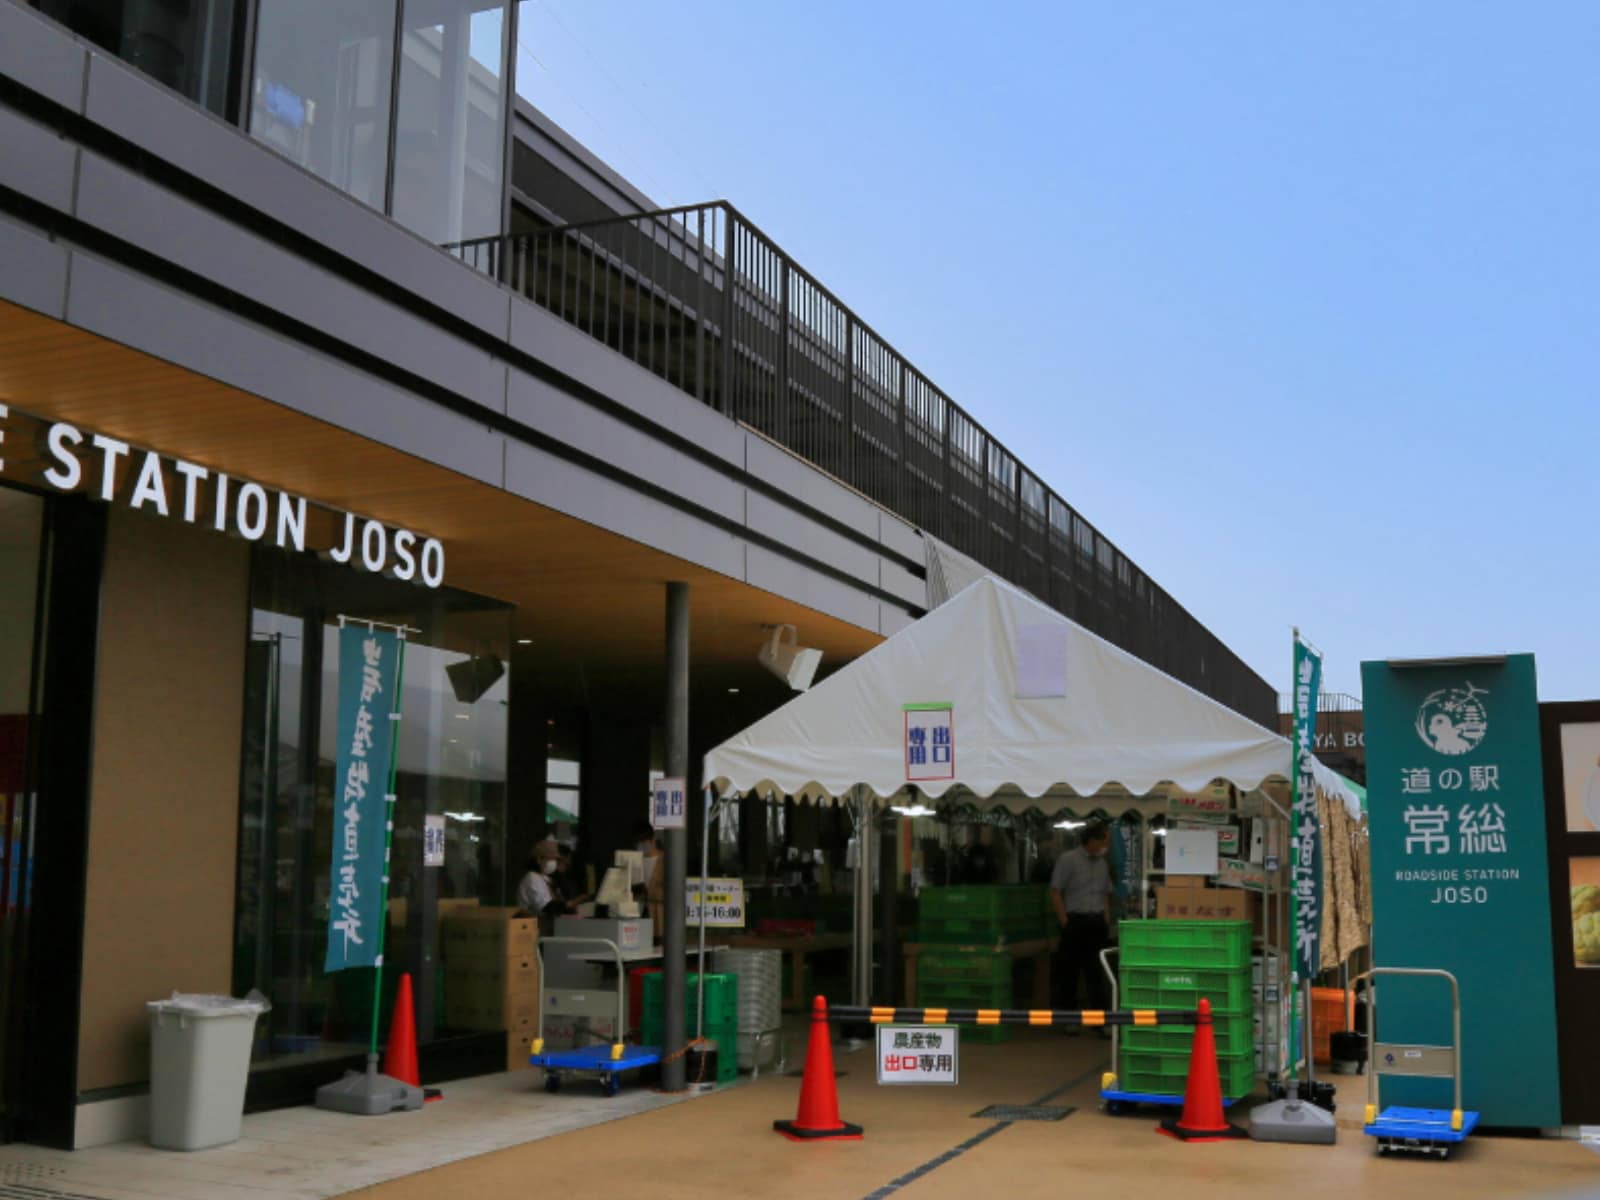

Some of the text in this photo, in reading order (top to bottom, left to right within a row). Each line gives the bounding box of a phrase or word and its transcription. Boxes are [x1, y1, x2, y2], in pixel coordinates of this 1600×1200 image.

[44, 422, 307, 552] STATION
[330, 511, 446, 589] JOSO
[1401, 765, 1500, 794] 道の駅
[1403, 803, 1507, 854] 常総
[1395, 868, 1520, 881] ROADSIDE STATION
[1431, 886, 1488, 904] JOSO
[893, 1032, 942, 1049] 農産物
[884, 1054, 953, 1072] 出口専用
